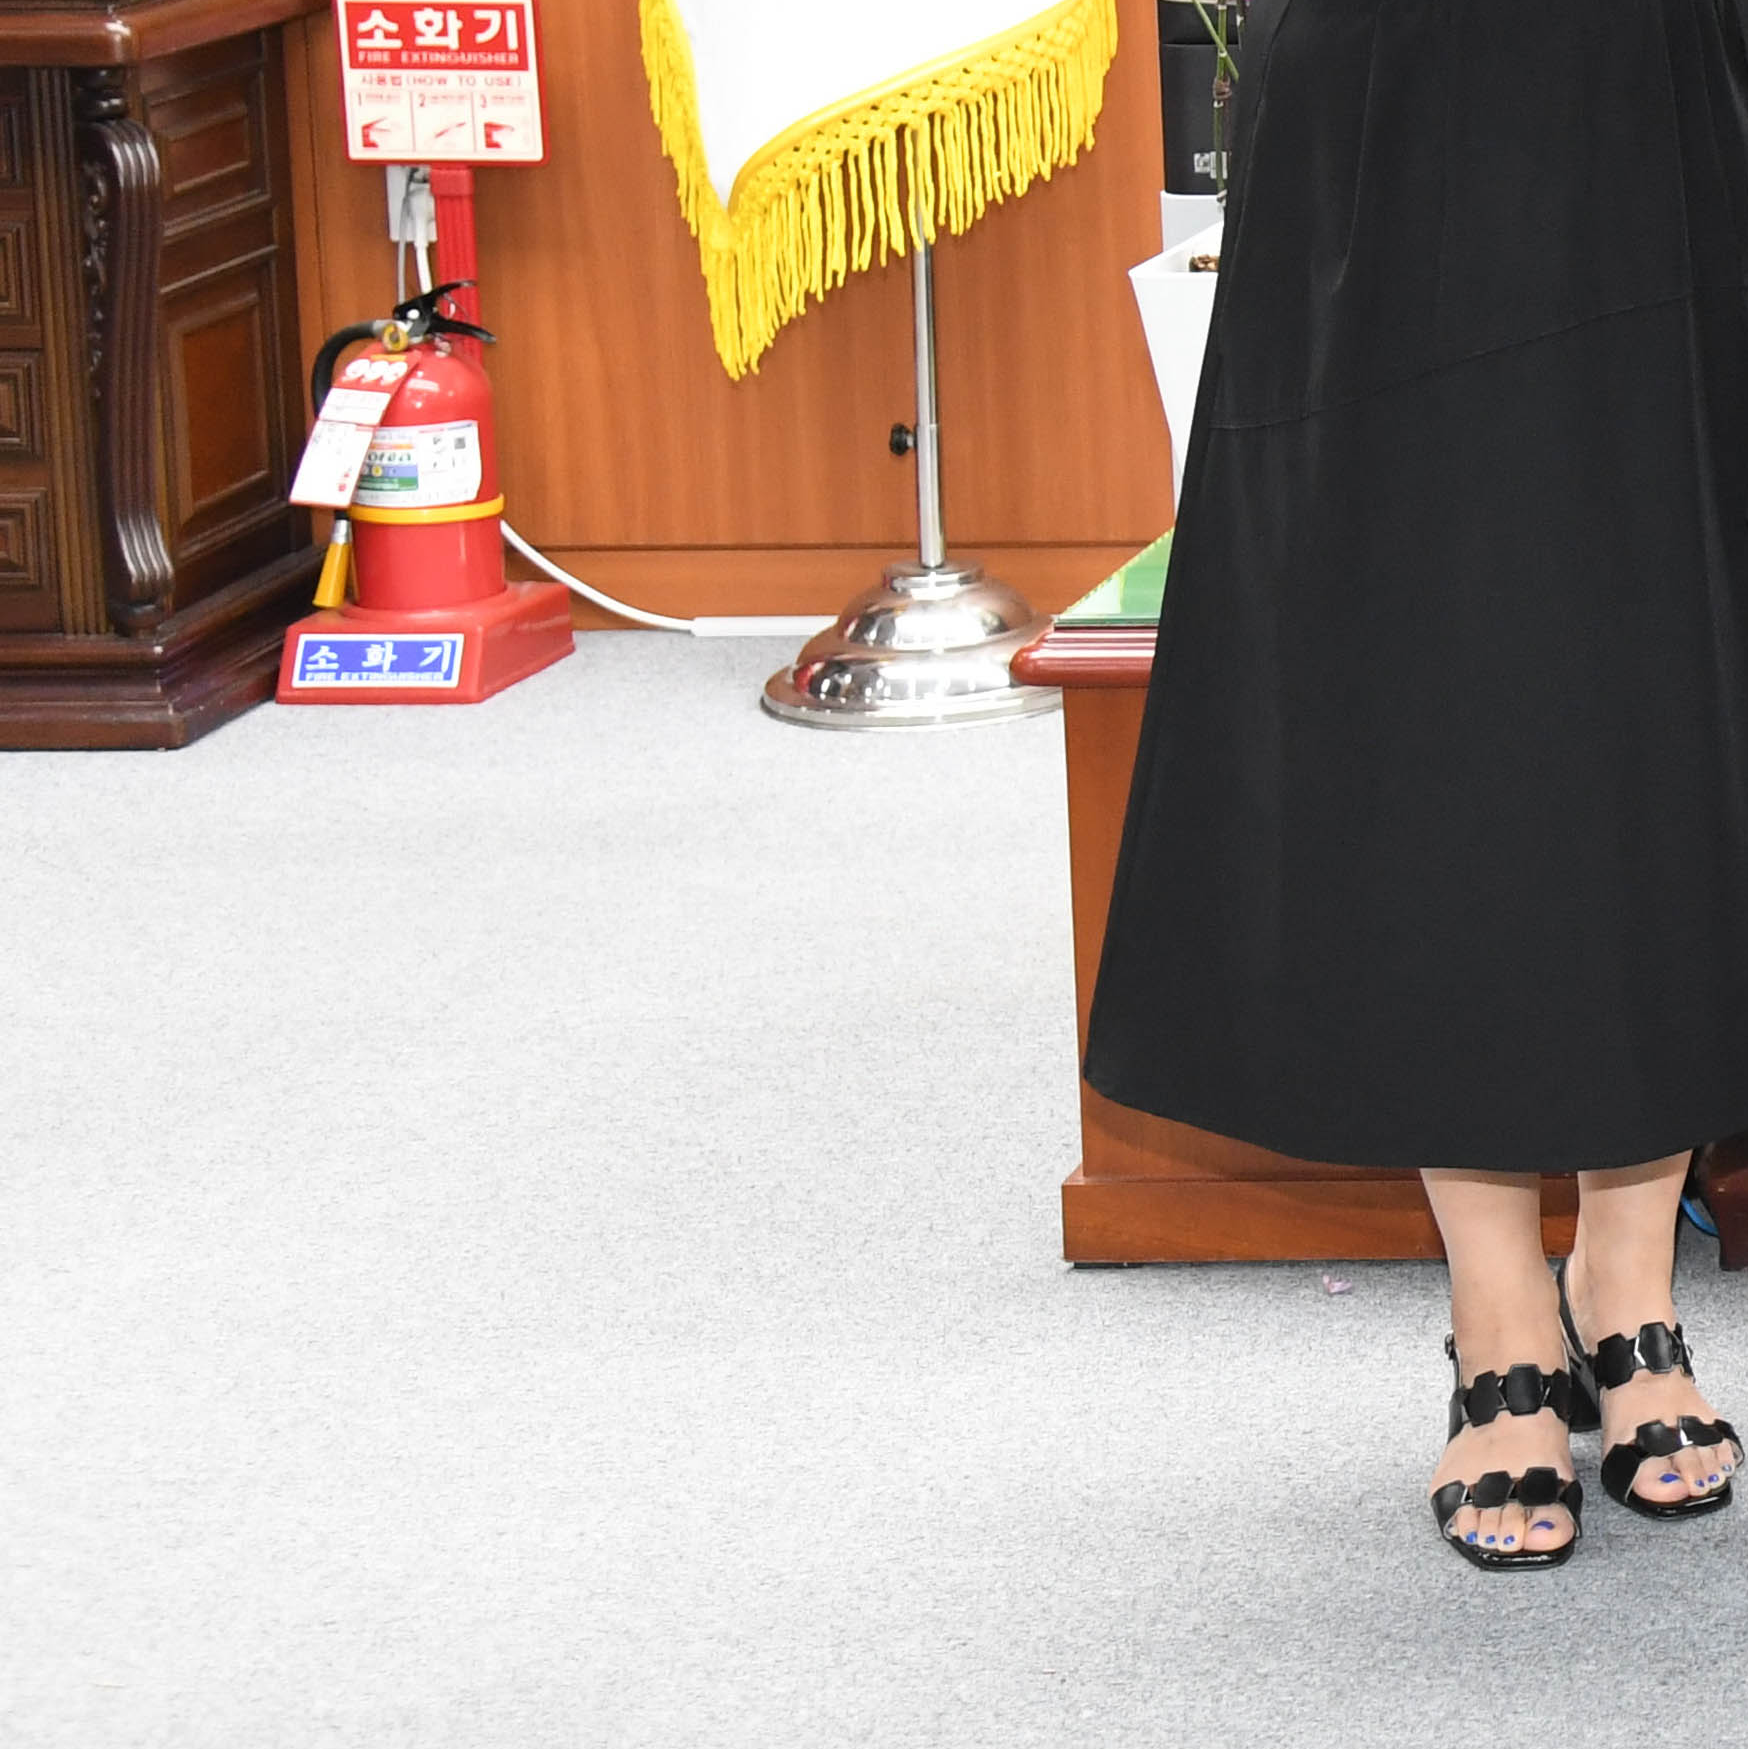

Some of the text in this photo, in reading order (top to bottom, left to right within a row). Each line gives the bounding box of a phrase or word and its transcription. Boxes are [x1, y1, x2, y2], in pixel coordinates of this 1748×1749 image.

[356, 8, 519, 51] 소화기
[357, 52, 519, 65] FIRE EXTINGUISHER
[457, 75, 477, 86] TO
[305, 641, 452, 673] 소화기
